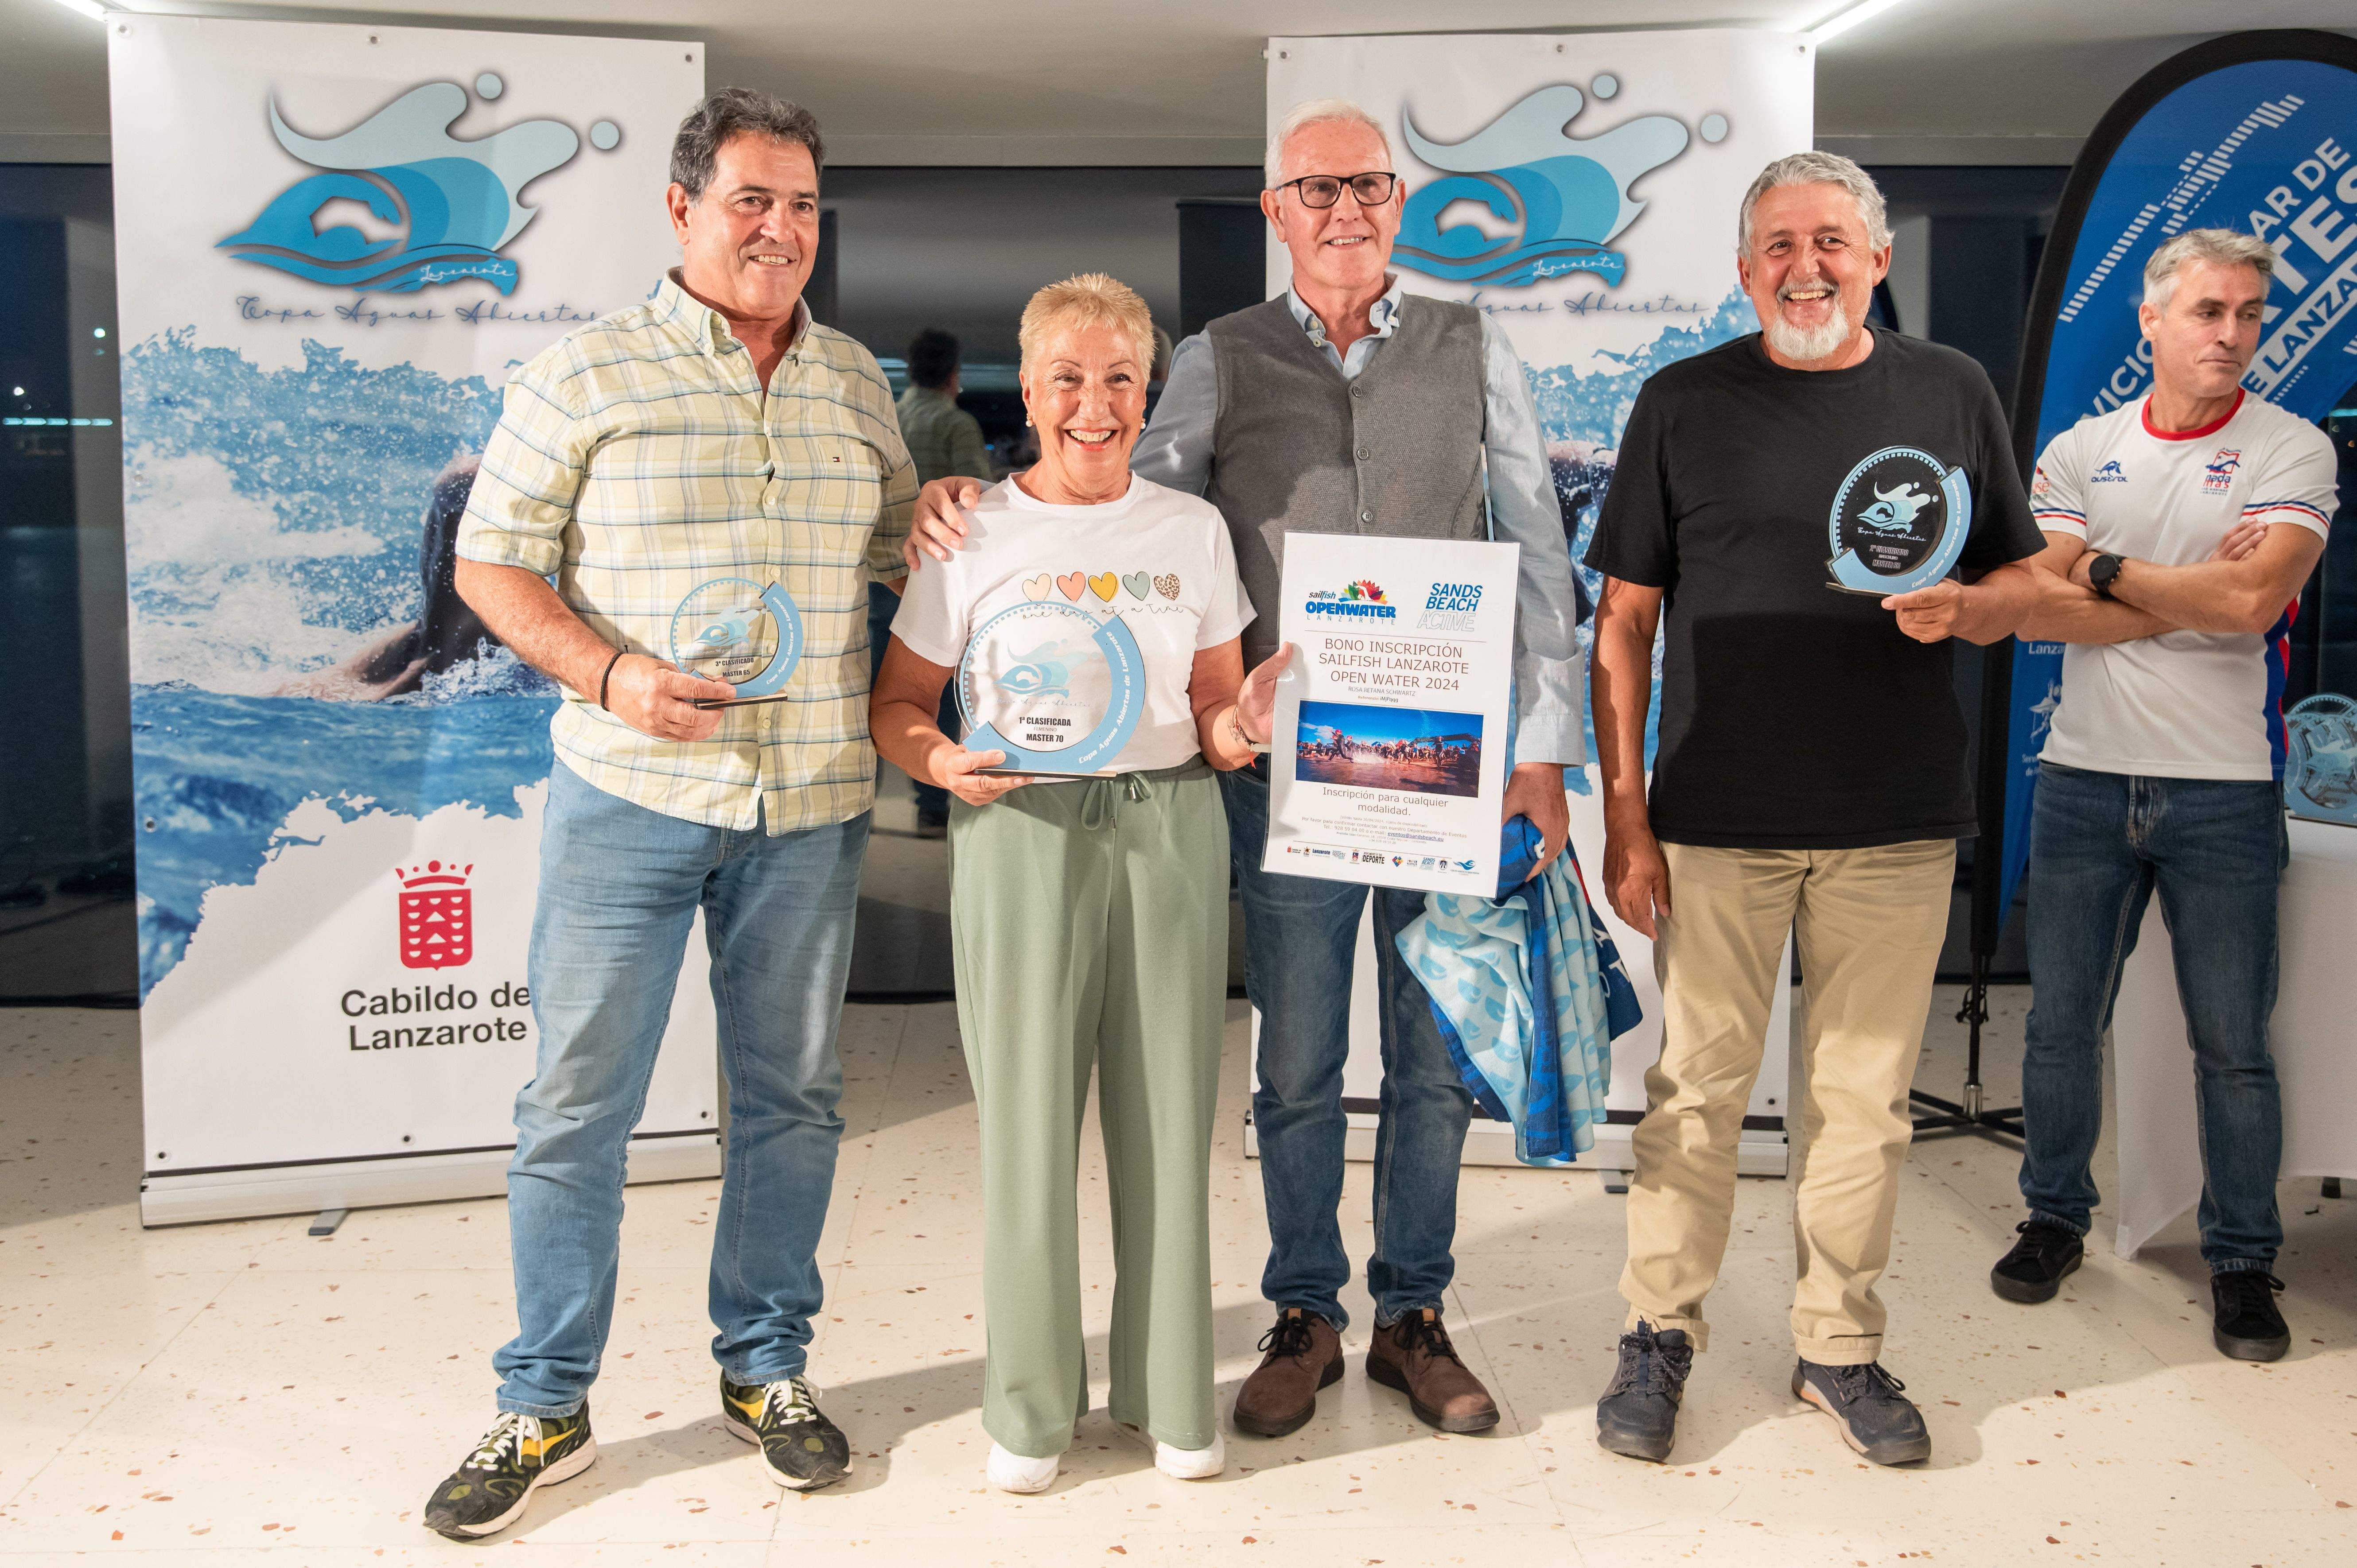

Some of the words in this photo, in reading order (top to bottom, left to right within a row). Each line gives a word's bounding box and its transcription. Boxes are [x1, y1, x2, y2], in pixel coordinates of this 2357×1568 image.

[2291, 137, 2350, 191] DE
[2261, 164, 2357, 324] TE
[420, 263, 514, 281] Lanzarote
[1532, 254, 1622, 276] Lanzarote
[237, 296, 325, 324] Copa
[335, 298, 445, 327] Aguas
[455, 300, 597, 325] Abiertas
[1564, 291, 1709, 317] Abiertas
[2238, 370, 2268, 394] E
[2262, 262, 2357, 374] LANZA
[1912, 576, 1927, 588] Copa
[1928, 559, 1945, 578] Aguas
[1944, 527, 1959, 559] Abiertas
[1956, 516, 1961, 526] de
[1872, 559, 1893, 569] MASTER
[1309, 590, 1336, 601] sailfish
[1430, 583, 1483, 598] SANDS
[1305, 601, 1396, 618] OPENWATER
[1425, 597, 1479, 611] BEACH
[1307, 614, 1395, 625] LANZAROTE
[1417, 610, 1476, 632] ACTIVE
[1106, 631, 1129, 672] Lanzarote
[1325, 638, 1364, 652] BONO
[1369, 641, 1462, 658] INSCRIPCIÓN
[722, 657, 754, 666] CLASIFICADO
[766, 674, 778, 685] Copa
[778, 657, 790, 675] Aguas
[1319, 653, 1381, 668] SAILFISH
[1387, 658, 1469, 674] LANZAROTE
[1124, 675, 1130, 687] de
[1330, 671, 1367, 683] OPEN
[1373, 673, 1420, 687] WATER
[1425, 677, 1459, 691] 2024
[1116, 689, 1130, 726] Abiertas
[1027, 717, 1071, 726] CLASIFICADA
[1026, 734, 1054, 742] MASTER
[1099, 727, 1118, 751] Aguas
[1078, 749, 1098, 764] Copa
[1323, 787, 1374, 800] Inscripción
[1378, 793, 1399, 802] para
[1403, 796, 1449, 807] cualquier
[1358, 804, 1411, 815] modalidad.
[1387, 832, 1444, 842] eventos@sandsbeach.eu
[1363, 855, 1385, 864] DEPORTE
[341, 984, 478, 1017] Cabildo
[491, 981, 531, 1008] de
[349, 1017, 527, 1052] Lanzarote
